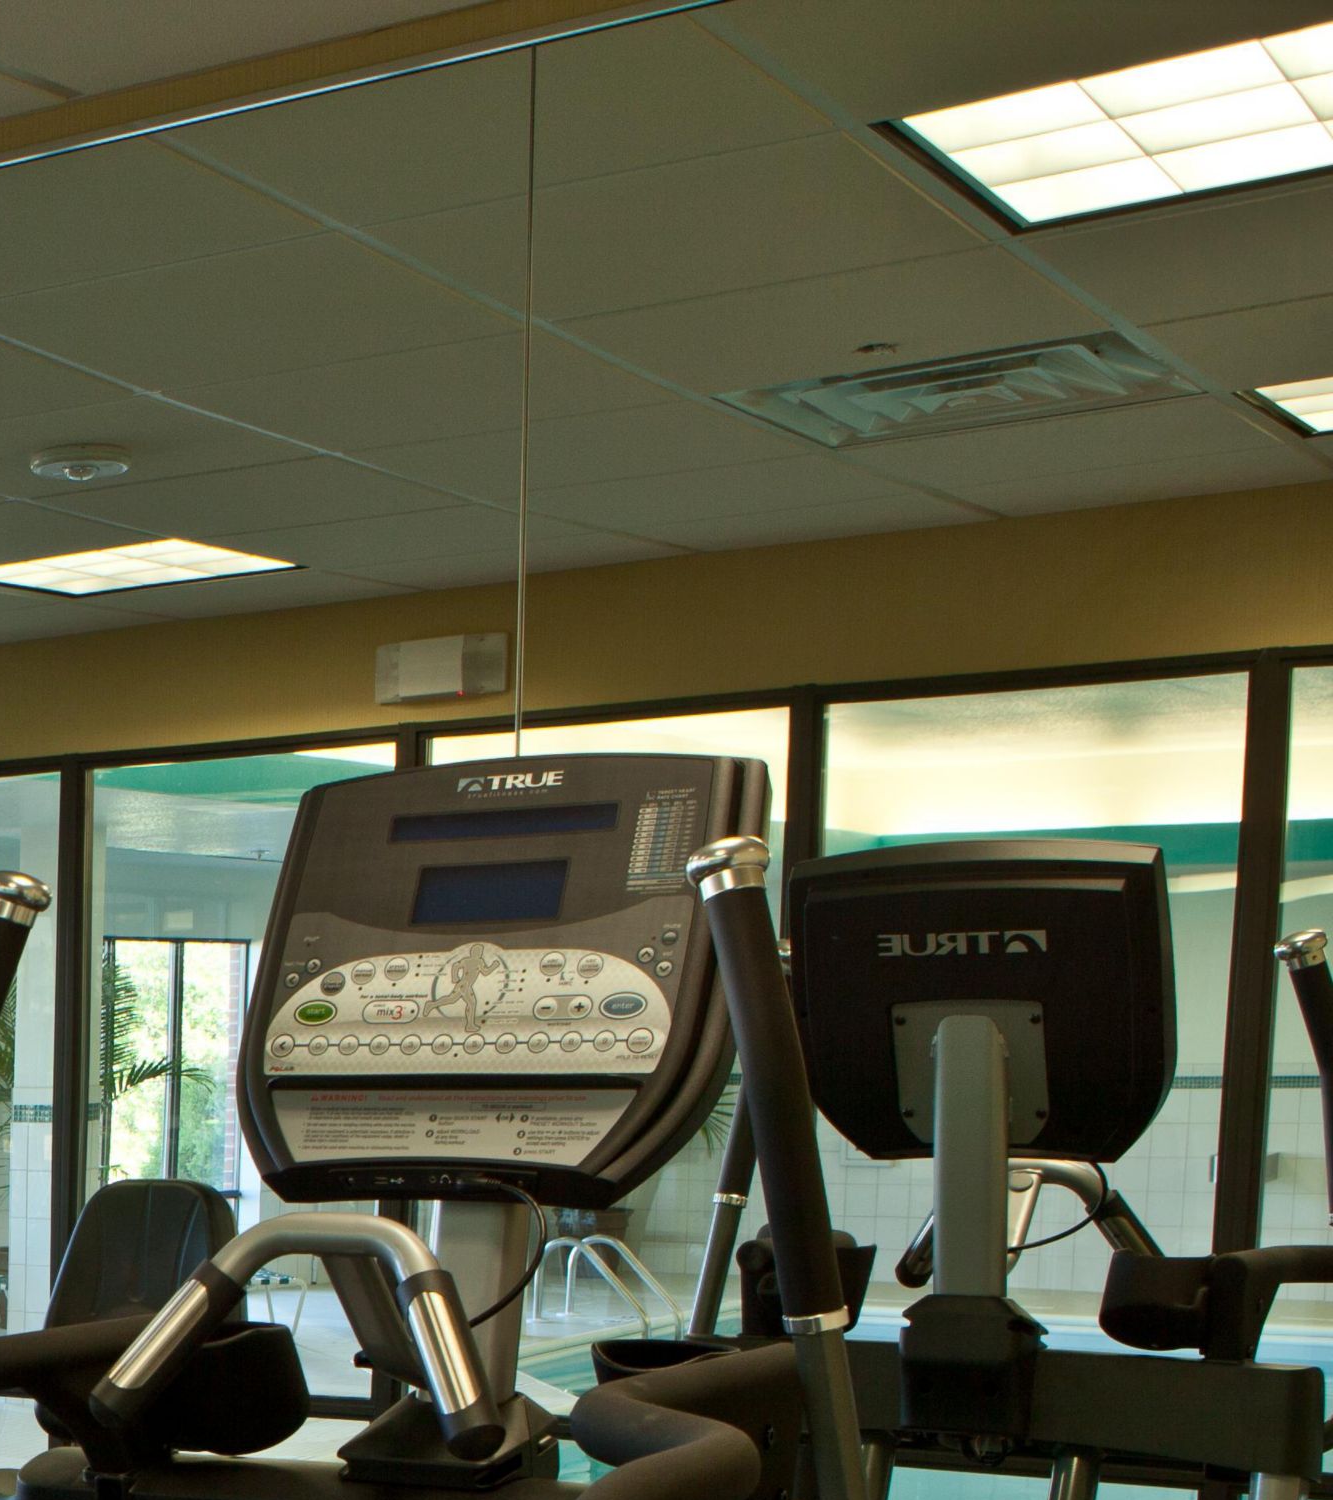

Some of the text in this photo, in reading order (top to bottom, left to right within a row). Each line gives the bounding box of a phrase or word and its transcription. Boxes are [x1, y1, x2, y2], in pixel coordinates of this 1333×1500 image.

[486, 770, 564, 791] TRUE
[611, 1001, 635, 1010] enter
[306, 1007, 325, 1015] start
[321, 1094, 367, 1102] WARNING!
